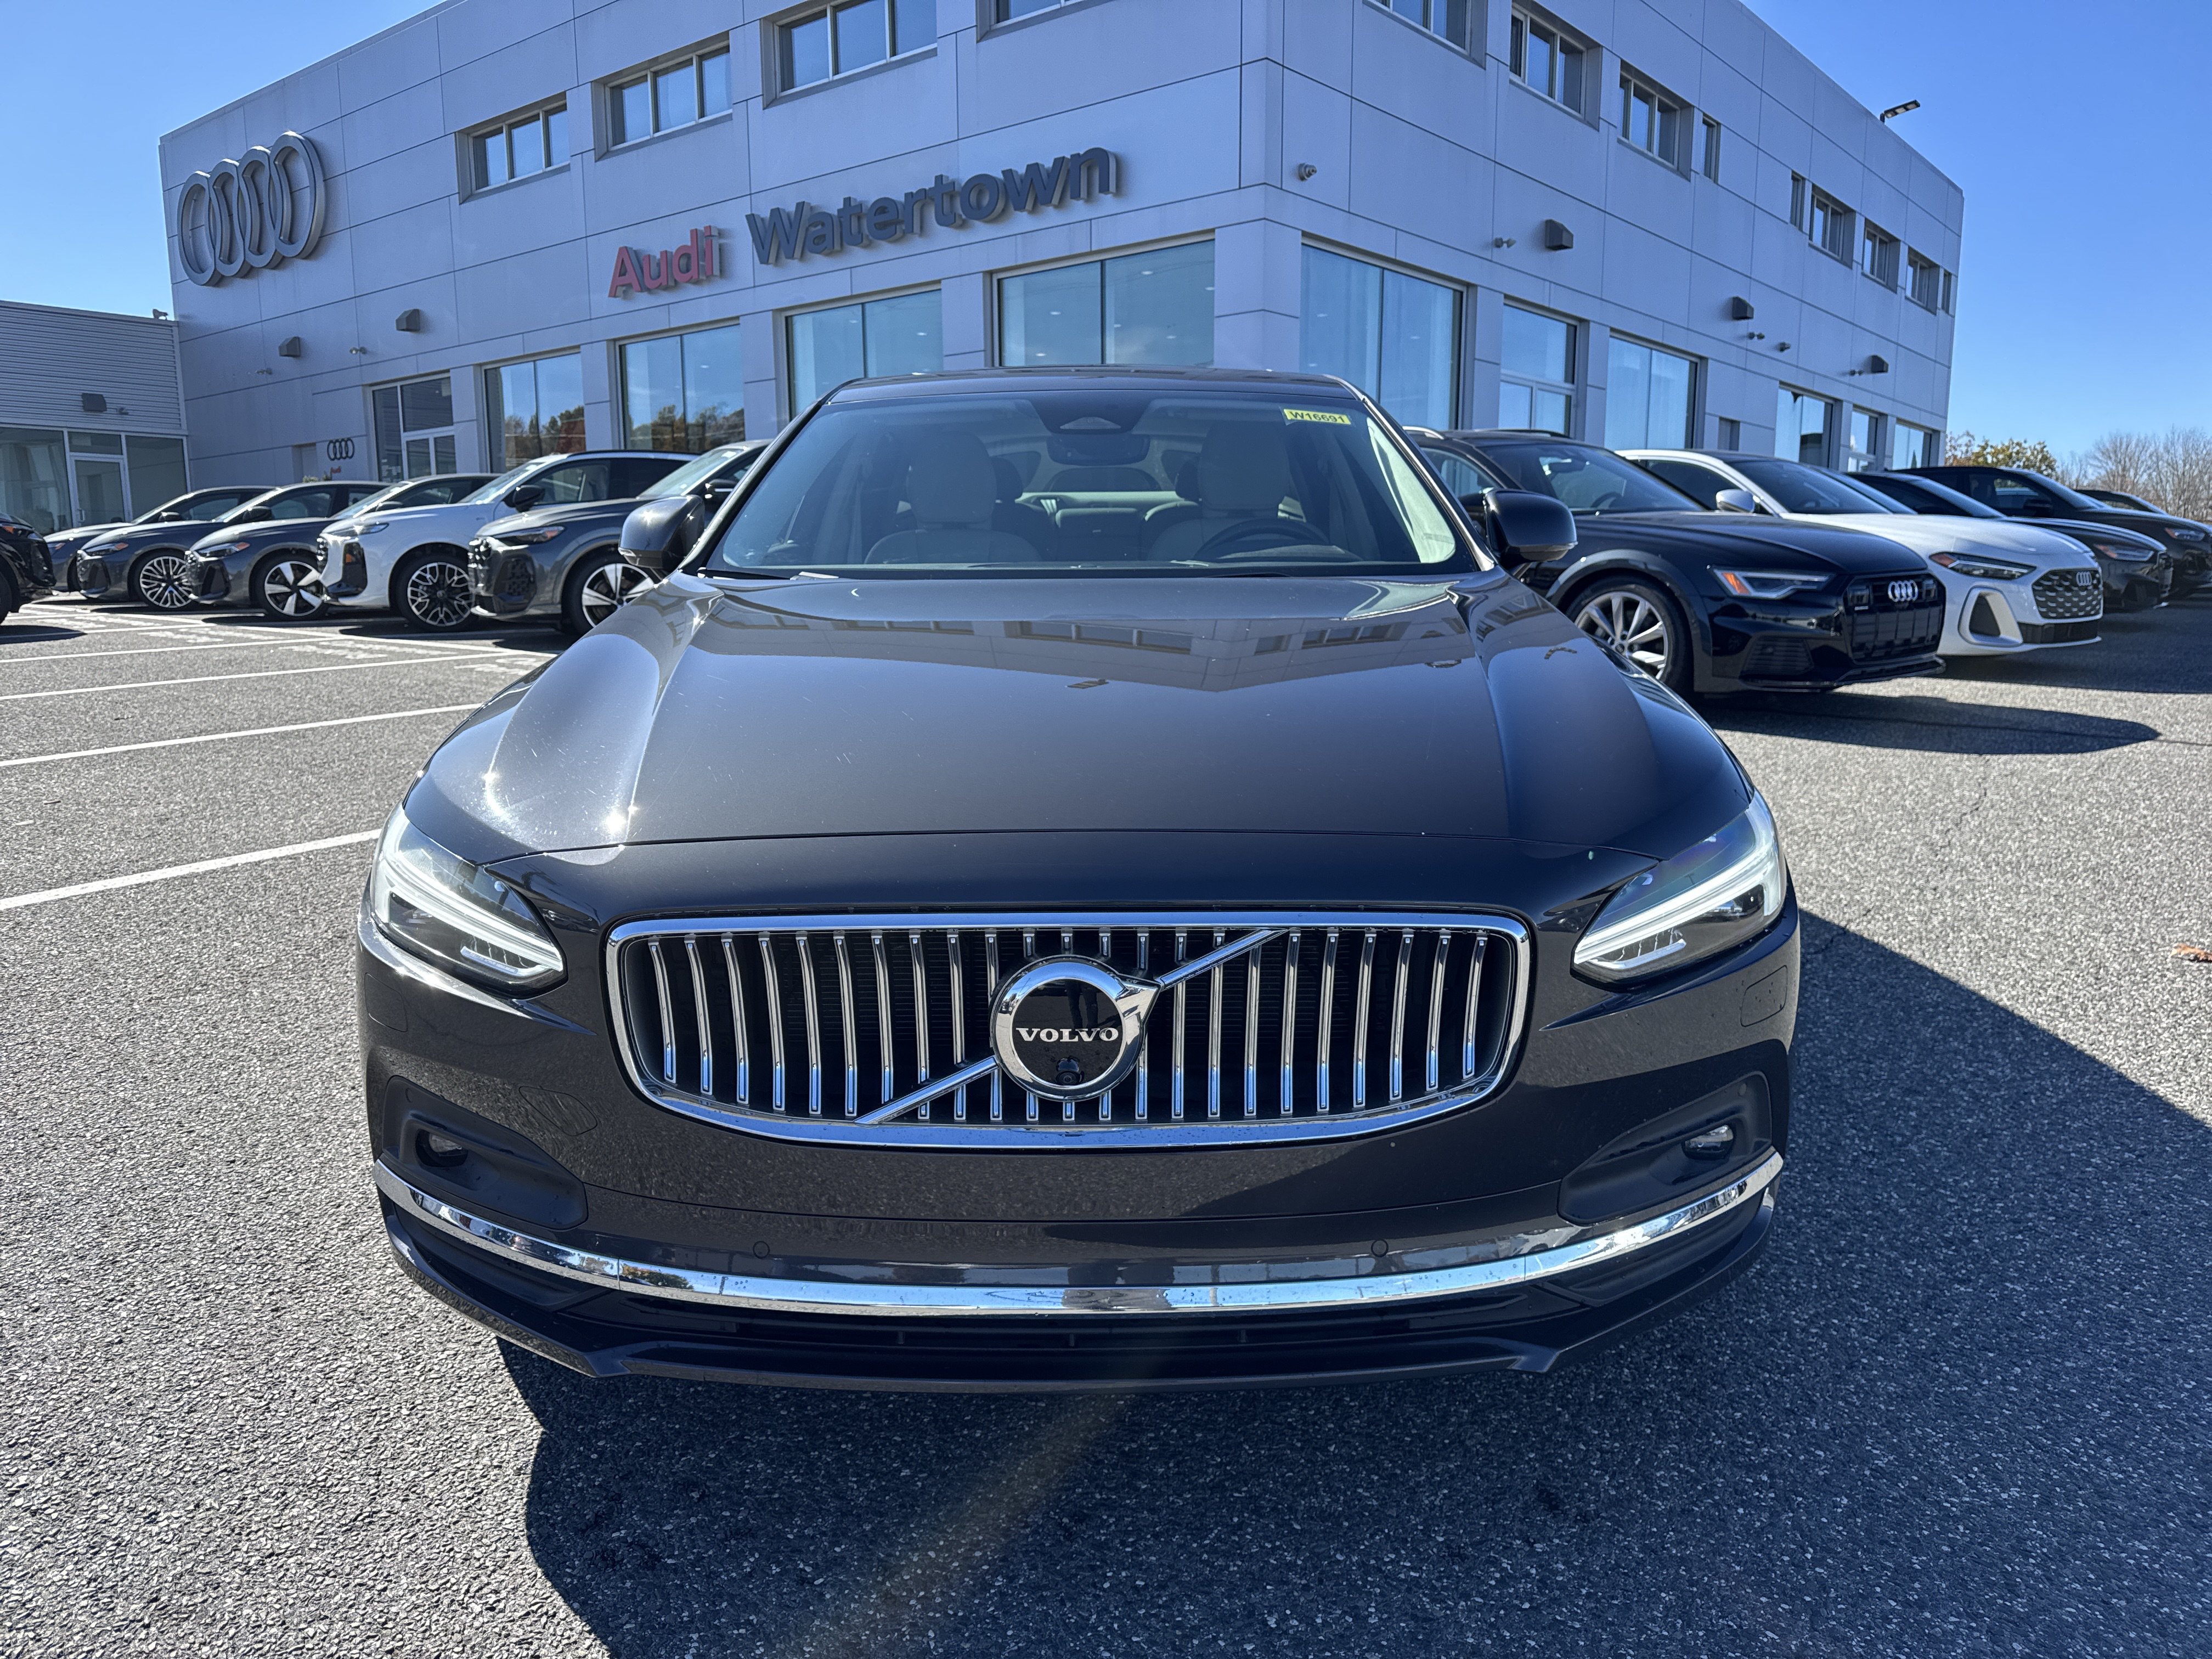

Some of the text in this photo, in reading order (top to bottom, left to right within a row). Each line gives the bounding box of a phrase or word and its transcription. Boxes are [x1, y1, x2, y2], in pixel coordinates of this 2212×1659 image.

[608, 146, 1117, 297] Audi Watertown
[1289, 411, 1346, 423] W16691
[1016, 1028, 1119, 1042] VOLVO
